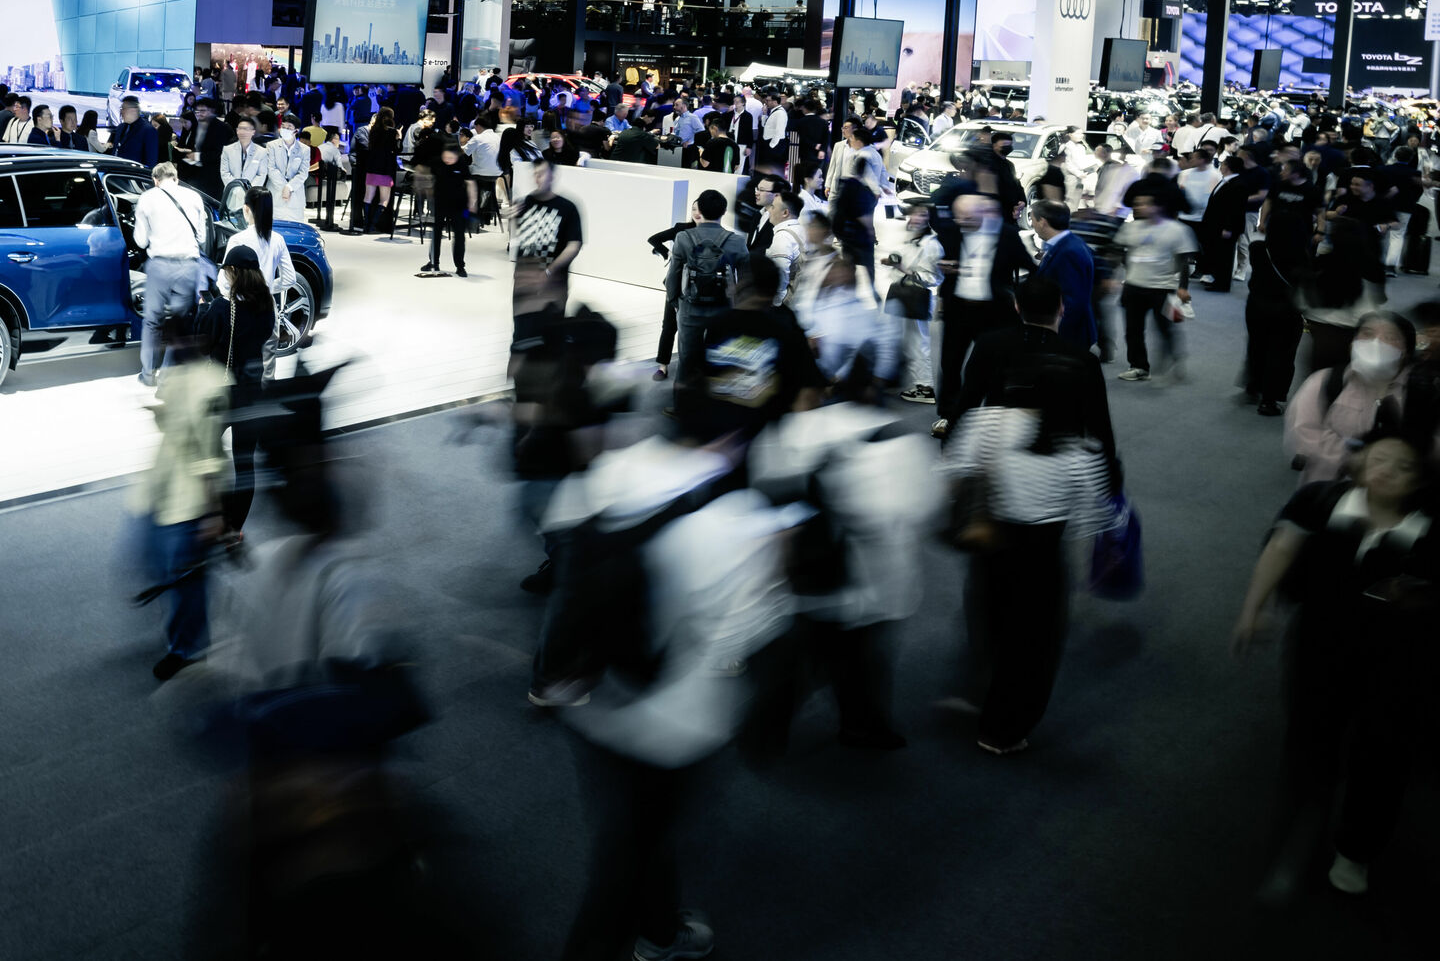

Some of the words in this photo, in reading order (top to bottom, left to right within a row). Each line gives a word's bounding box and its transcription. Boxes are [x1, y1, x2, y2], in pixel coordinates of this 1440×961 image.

[1314, 1, 1385, 14] TOOTA
[1360, 53, 1393, 61] TOYOTA
[428, 58, 448, 66] e-tron
